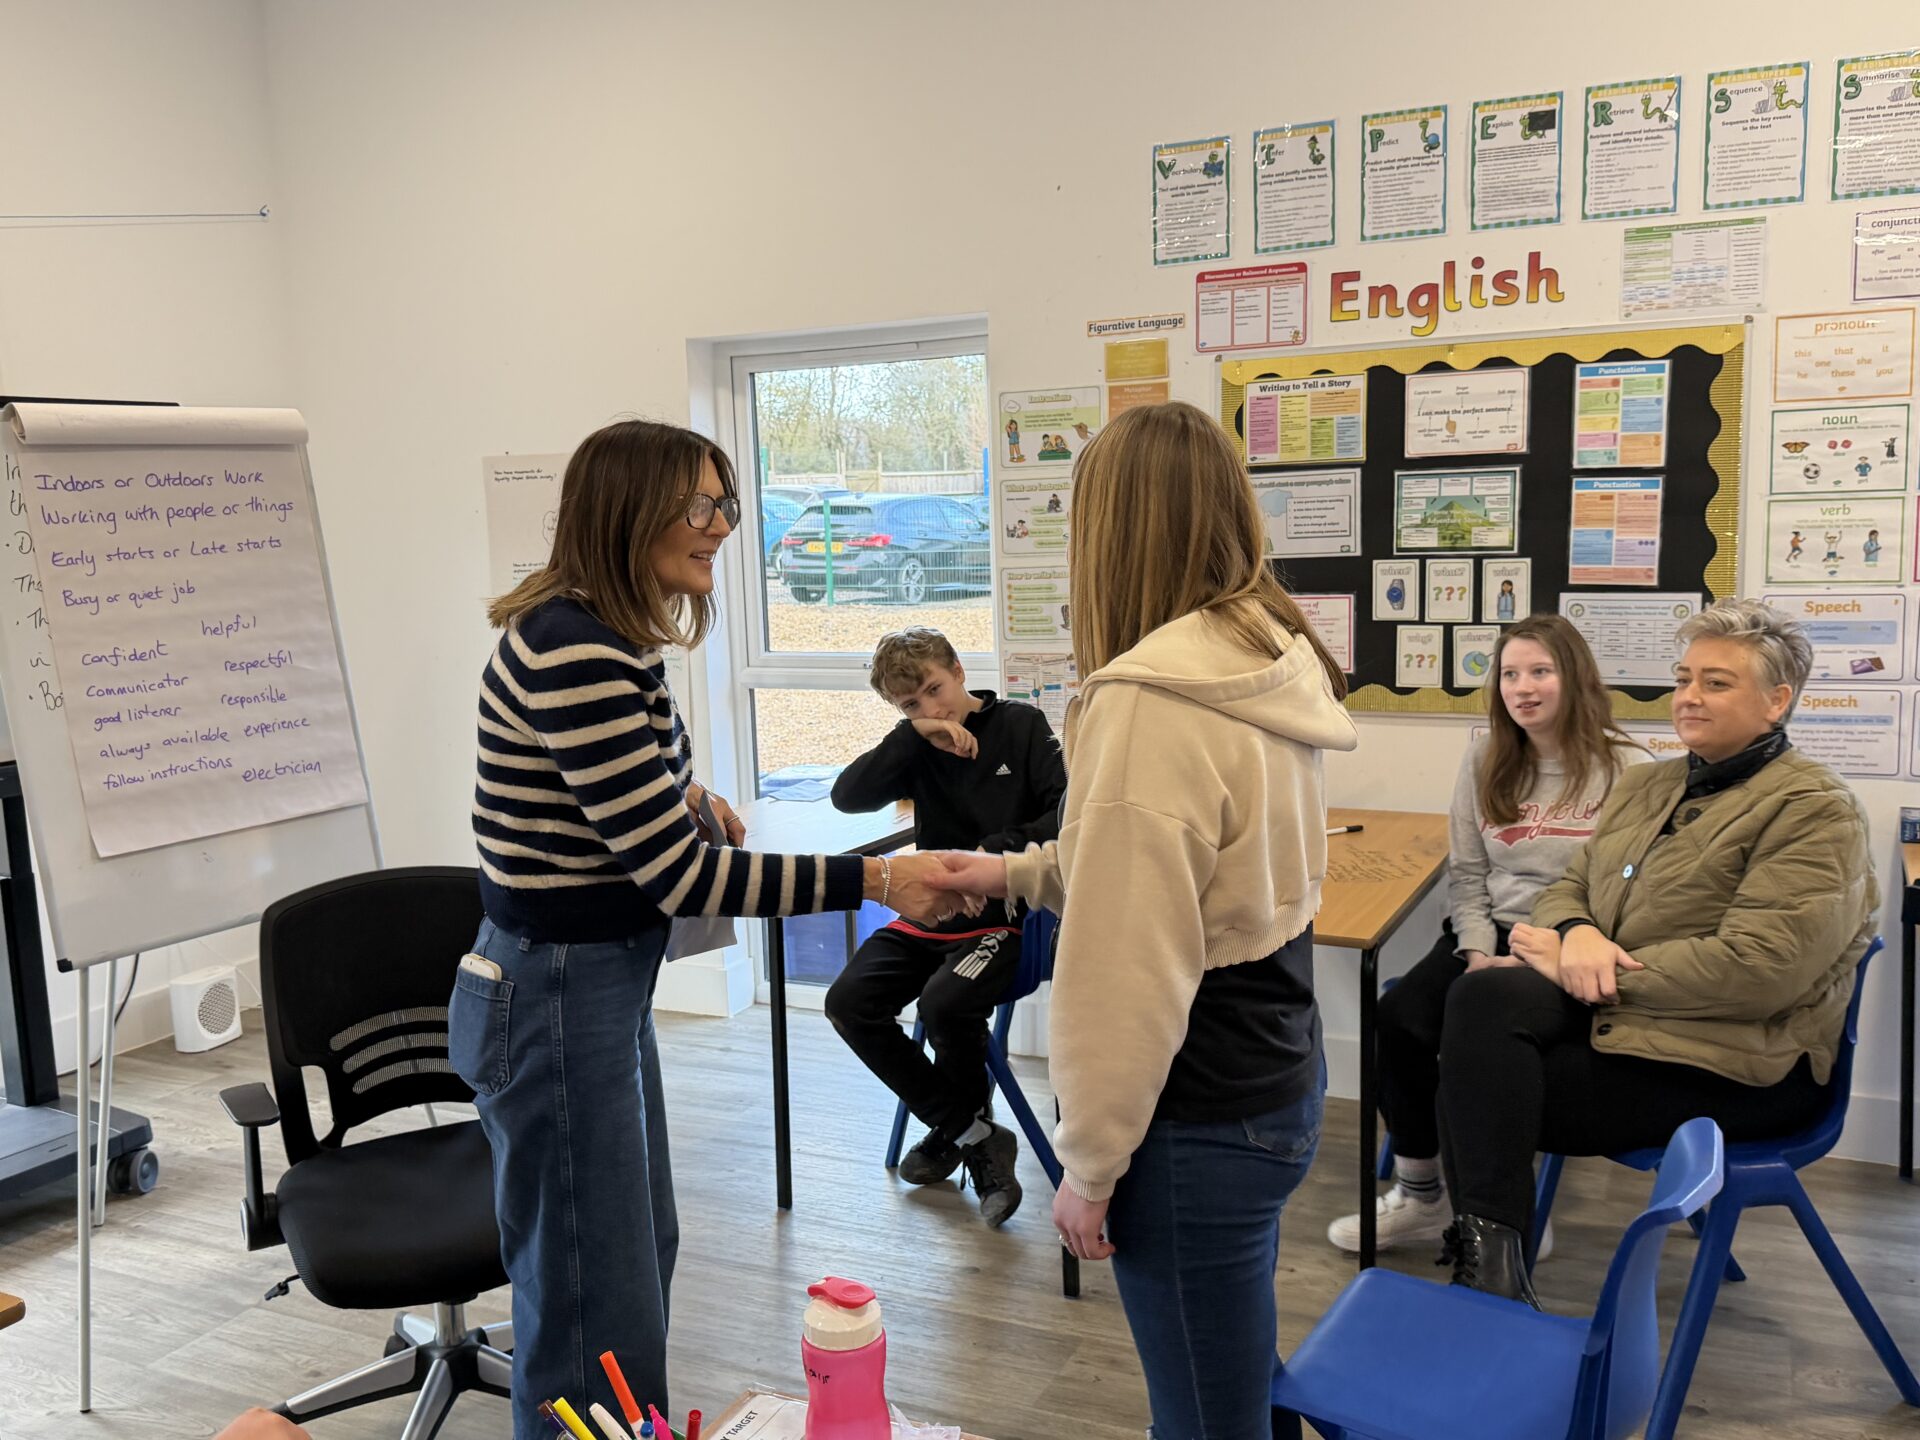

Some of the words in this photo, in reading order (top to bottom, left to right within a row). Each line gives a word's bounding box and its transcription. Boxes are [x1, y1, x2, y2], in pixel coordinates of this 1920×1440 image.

[1844, 71, 1900, 100] Summarise
[1715, 86, 1763, 114] Sequence
[1593, 101, 1635, 127] Retrieve
[1481, 115, 1514, 140] Explain
[1370, 129, 1399, 153] Predict
[1261, 144, 1284, 165] Infer
[1330, 251, 1565, 337] English
[1088, 320, 1136, 334] Figurative
[1138, 317, 1184, 331] Language
[1834, 346, 1854, 356] that
[1882, 344, 1890, 353] it
[1856, 356, 1872, 365] she
[1598, 366, 1646, 375] Punctuation
[1830, 368, 1856, 378] these
[1876, 367, 1893, 378] you
[1259, 385, 1291, 393] Writing
[1302, 381, 1319, 390] Tell
[1328, 380, 1351, 388] Story
[1822, 415, 1858, 425] noun
[35, 474, 105, 491] Indoors
[115, 475, 134, 489] or
[145, 472, 214, 489] Outdoors
[224, 469, 265, 485] Work
[1593, 480, 1641, 489] Punctuation
[41, 505, 118, 534] Working
[125, 503, 162, 522] with
[166, 503, 215, 528] people
[223, 501, 240, 516] or
[245, 497, 294, 523] things
[1820, 504, 1851, 516] verb
[51, 550, 96, 576] Early
[106, 546, 155, 562] starts
[164, 546, 181, 559] or
[190, 541, 228, 557] Late
[237, 537, 282, 552] starts
[63, 589, 101, 616] Busy
[106, 590, 121, 604] or
[129, 587, 163, 609] quiet
[173, 580, 196, 604] job
[1804, 600, 1862, 616] Speech
[201, 614, 257, 638] helpful
[224, 651, 293, 675] respectful
[220, 685, 287, 707] responsible
[1801, 695, 1858, 710] Speech
[94, 712, 123, 732] good
[128, 705, 182, 722] listener
[243, 717, 311, 738] experience
[100, 743, 152, 762] always
[162, 729, 230, 747] available
[1648, 737, 1690, 752] Spee
[103, 771, 145, 791] follow
[150, 755, 233, 782] instructions
[242, 760, 321, 783] electrician
[726, 1410, 759, 1436] TARGET
